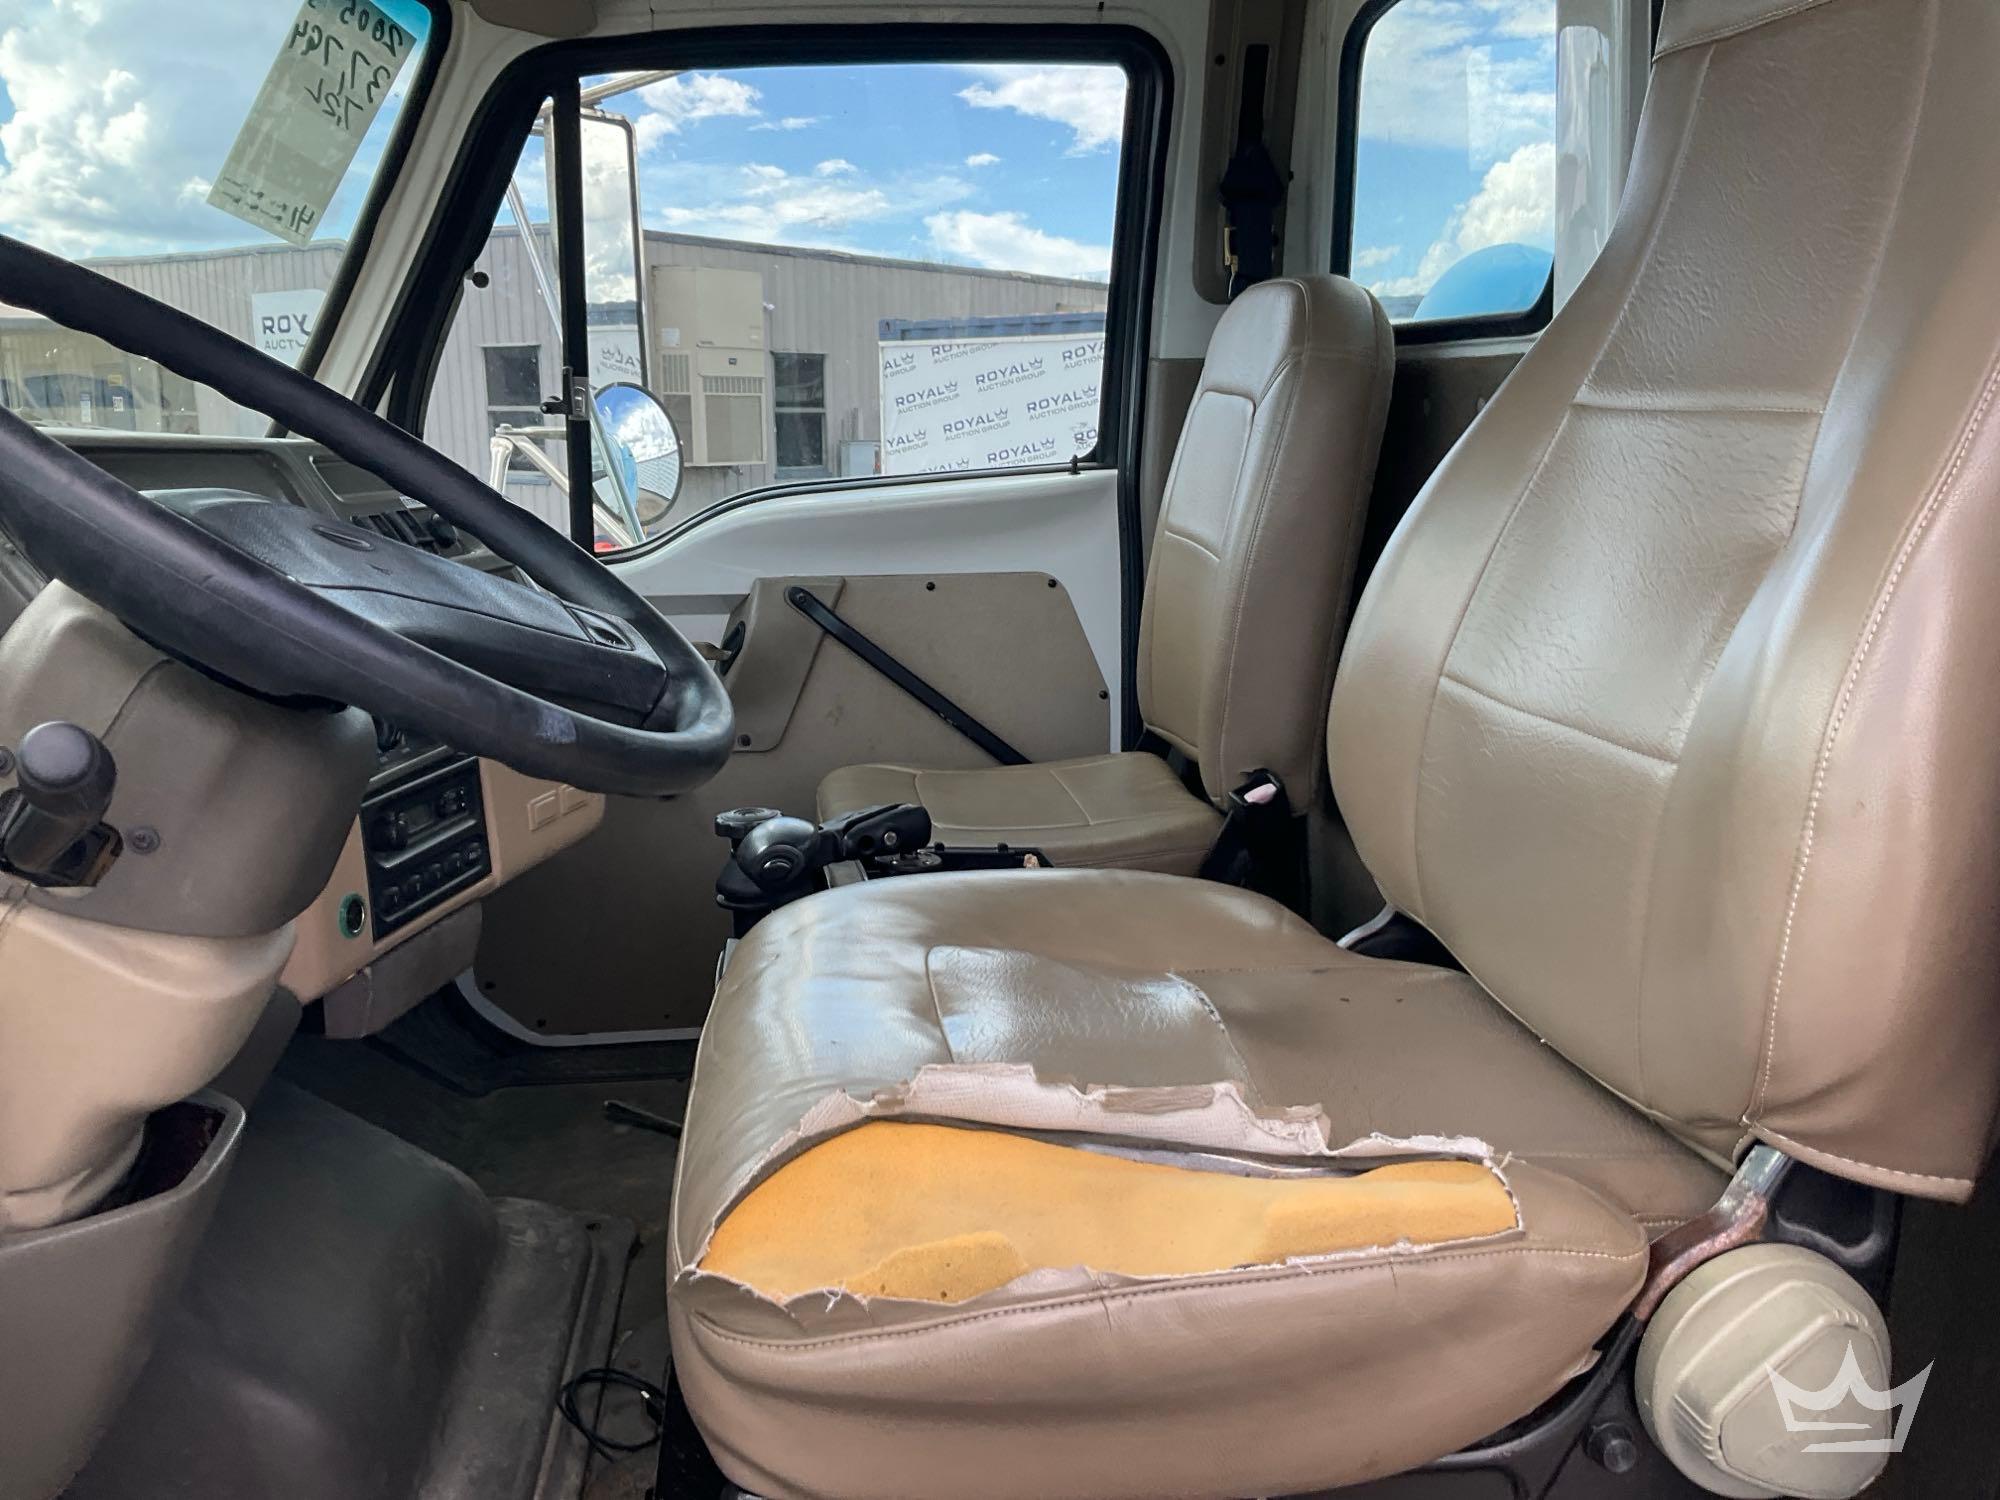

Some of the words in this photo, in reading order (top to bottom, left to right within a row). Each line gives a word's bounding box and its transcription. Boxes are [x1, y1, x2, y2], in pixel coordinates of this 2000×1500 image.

[261, 313, 311, 335] ROY
[976, 361, 1029, 385] ROYAL
[978, 377, 1014, 392] AUCTION
[895, 386, 945, 407] ROYAL
[1027, 389, 1083, 413] ROYAL
[898, 399, 931, 415] AUCTION
[1029, 405, 1067, 421] AUCTION
[943, 413, 995, 434] ROYAL
[887, 434, 914, 448] YAL
[945, 428, 980, 442] AUCTION
[987, 443, 1041, 463] ROYAL
